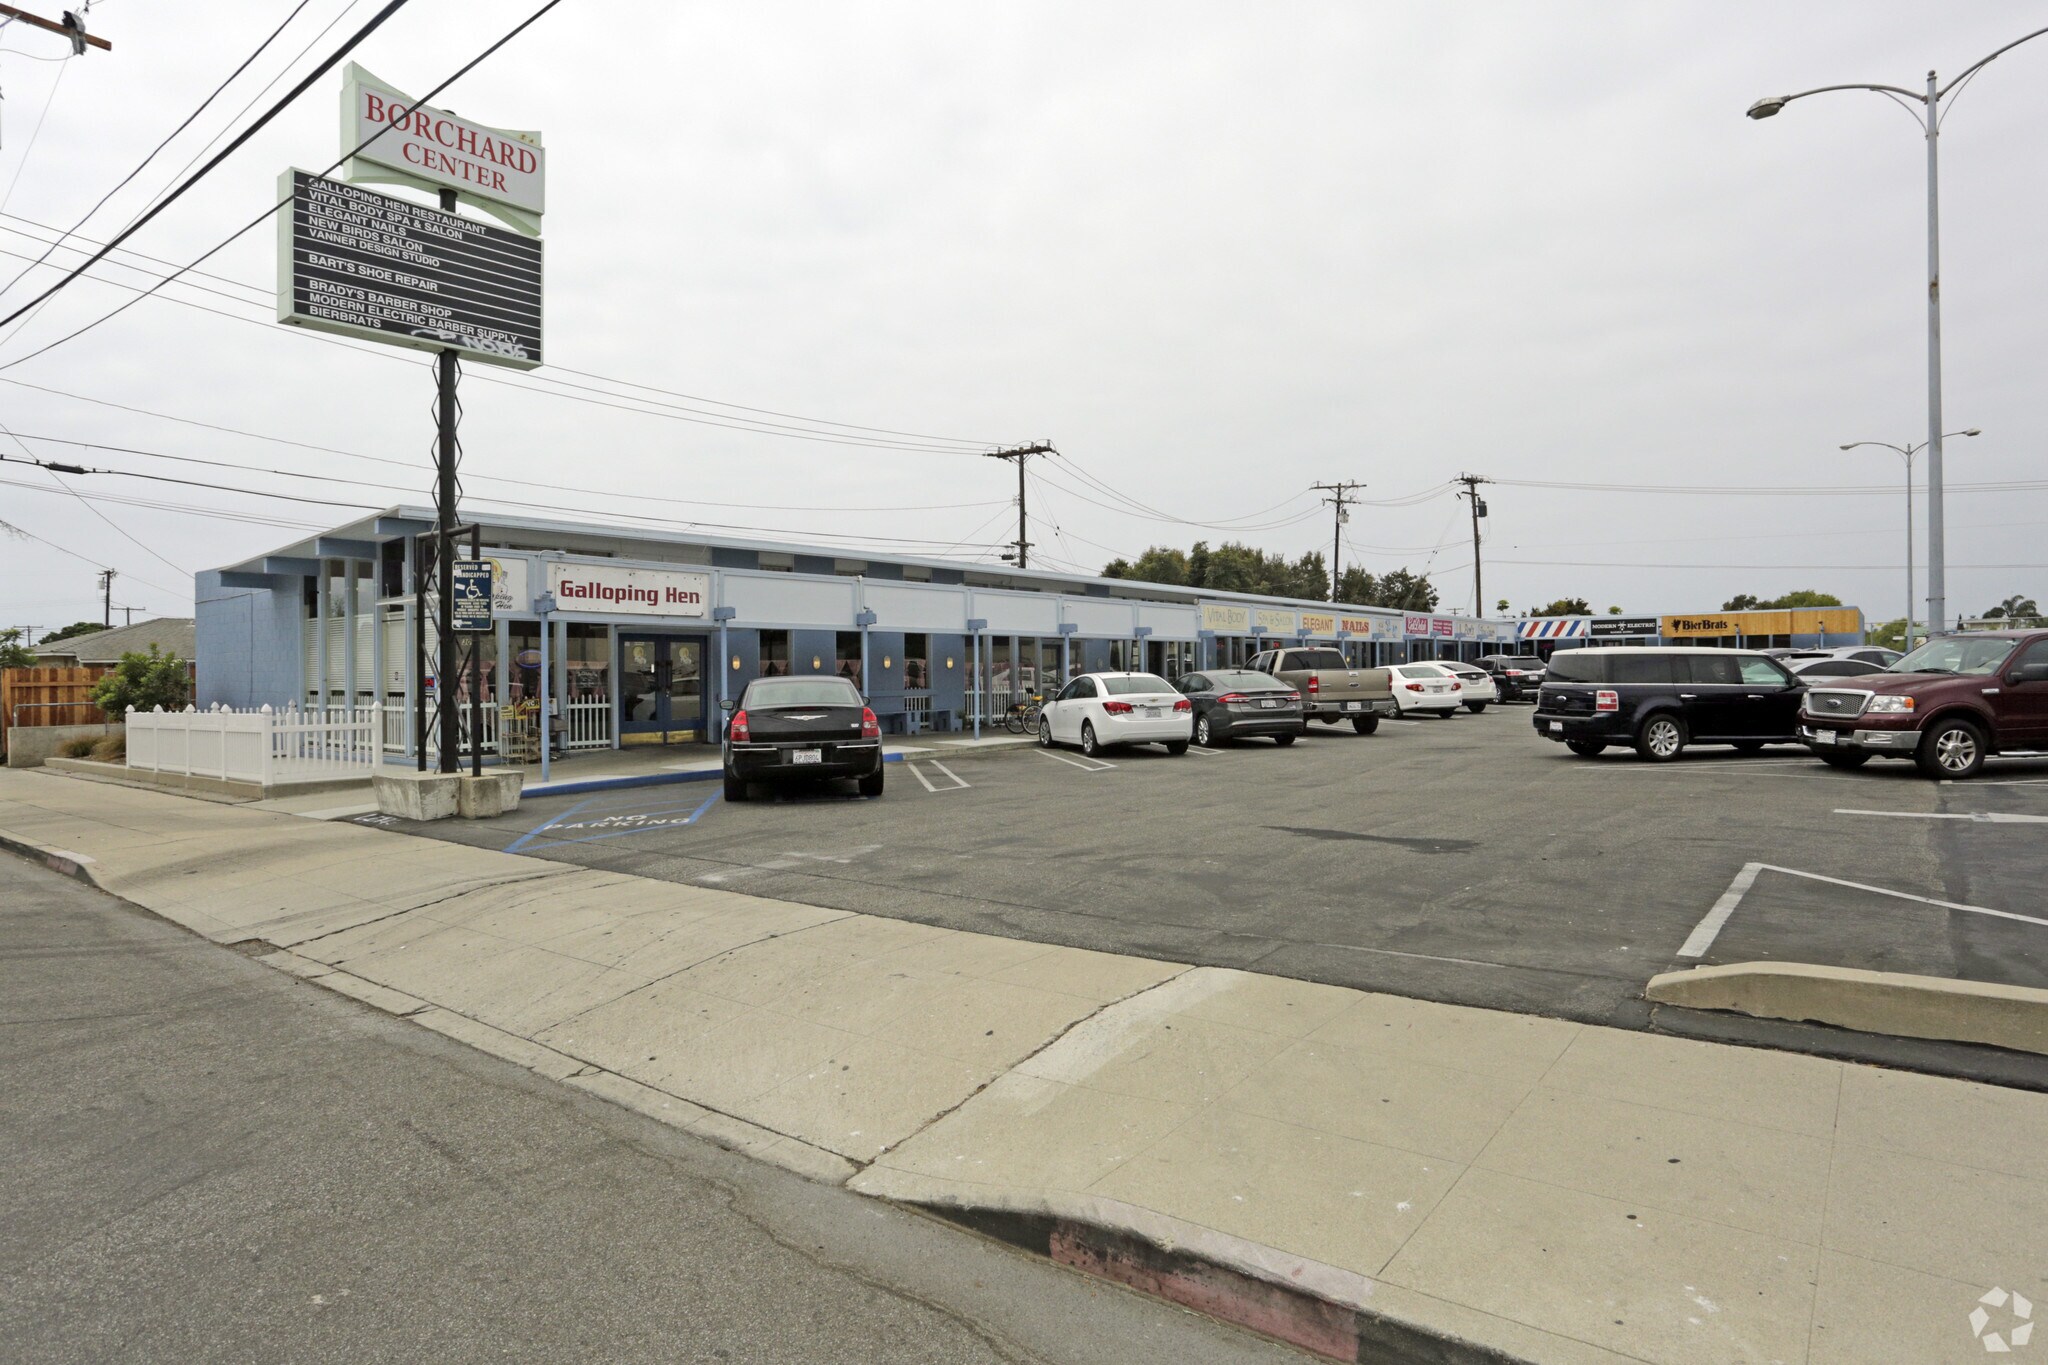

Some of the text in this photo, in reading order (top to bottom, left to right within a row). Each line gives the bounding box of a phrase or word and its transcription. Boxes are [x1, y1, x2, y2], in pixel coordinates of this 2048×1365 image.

[364, 93, 537, 174] BORCHARD
[402, 142, 508, 193] CENTER
[309, 178, 486, 235] GALLOPING HEN RESTAURANT
[309, 190, 463, 240] VITAL BODY SPA & SALON
[309, 203, 407, 236] ELEGANT NAILS
[309, 216, 423, 252] NEW BIRDS SALON
[309, 228, 440, 267] VANNER DESIGN STUDIO
[309, 254, 438, 291] BART'S SHOE REPAIR
[309, 280, 452, 318] BRADY'S BARBER SHOP
[309, 306, 381, 328] BIERBRATS
[309, 293, 365, 313] MODERN
[368, 306, 425, 325] ELECTRIC
[428, 319, 474, 335] BARBER
[477, 328, 517, 344] SUPPLY
[560, 580, 701, 606] Galloping Hen
[1303, 617, 1333, 631] ELEGANT
[1341, 620, 1370, 633] NAILS
[1682, 619, 1728, 630] BierBrats
[543, 817, 691, 831] PARKING
[602, 814, 648, 822] NO
